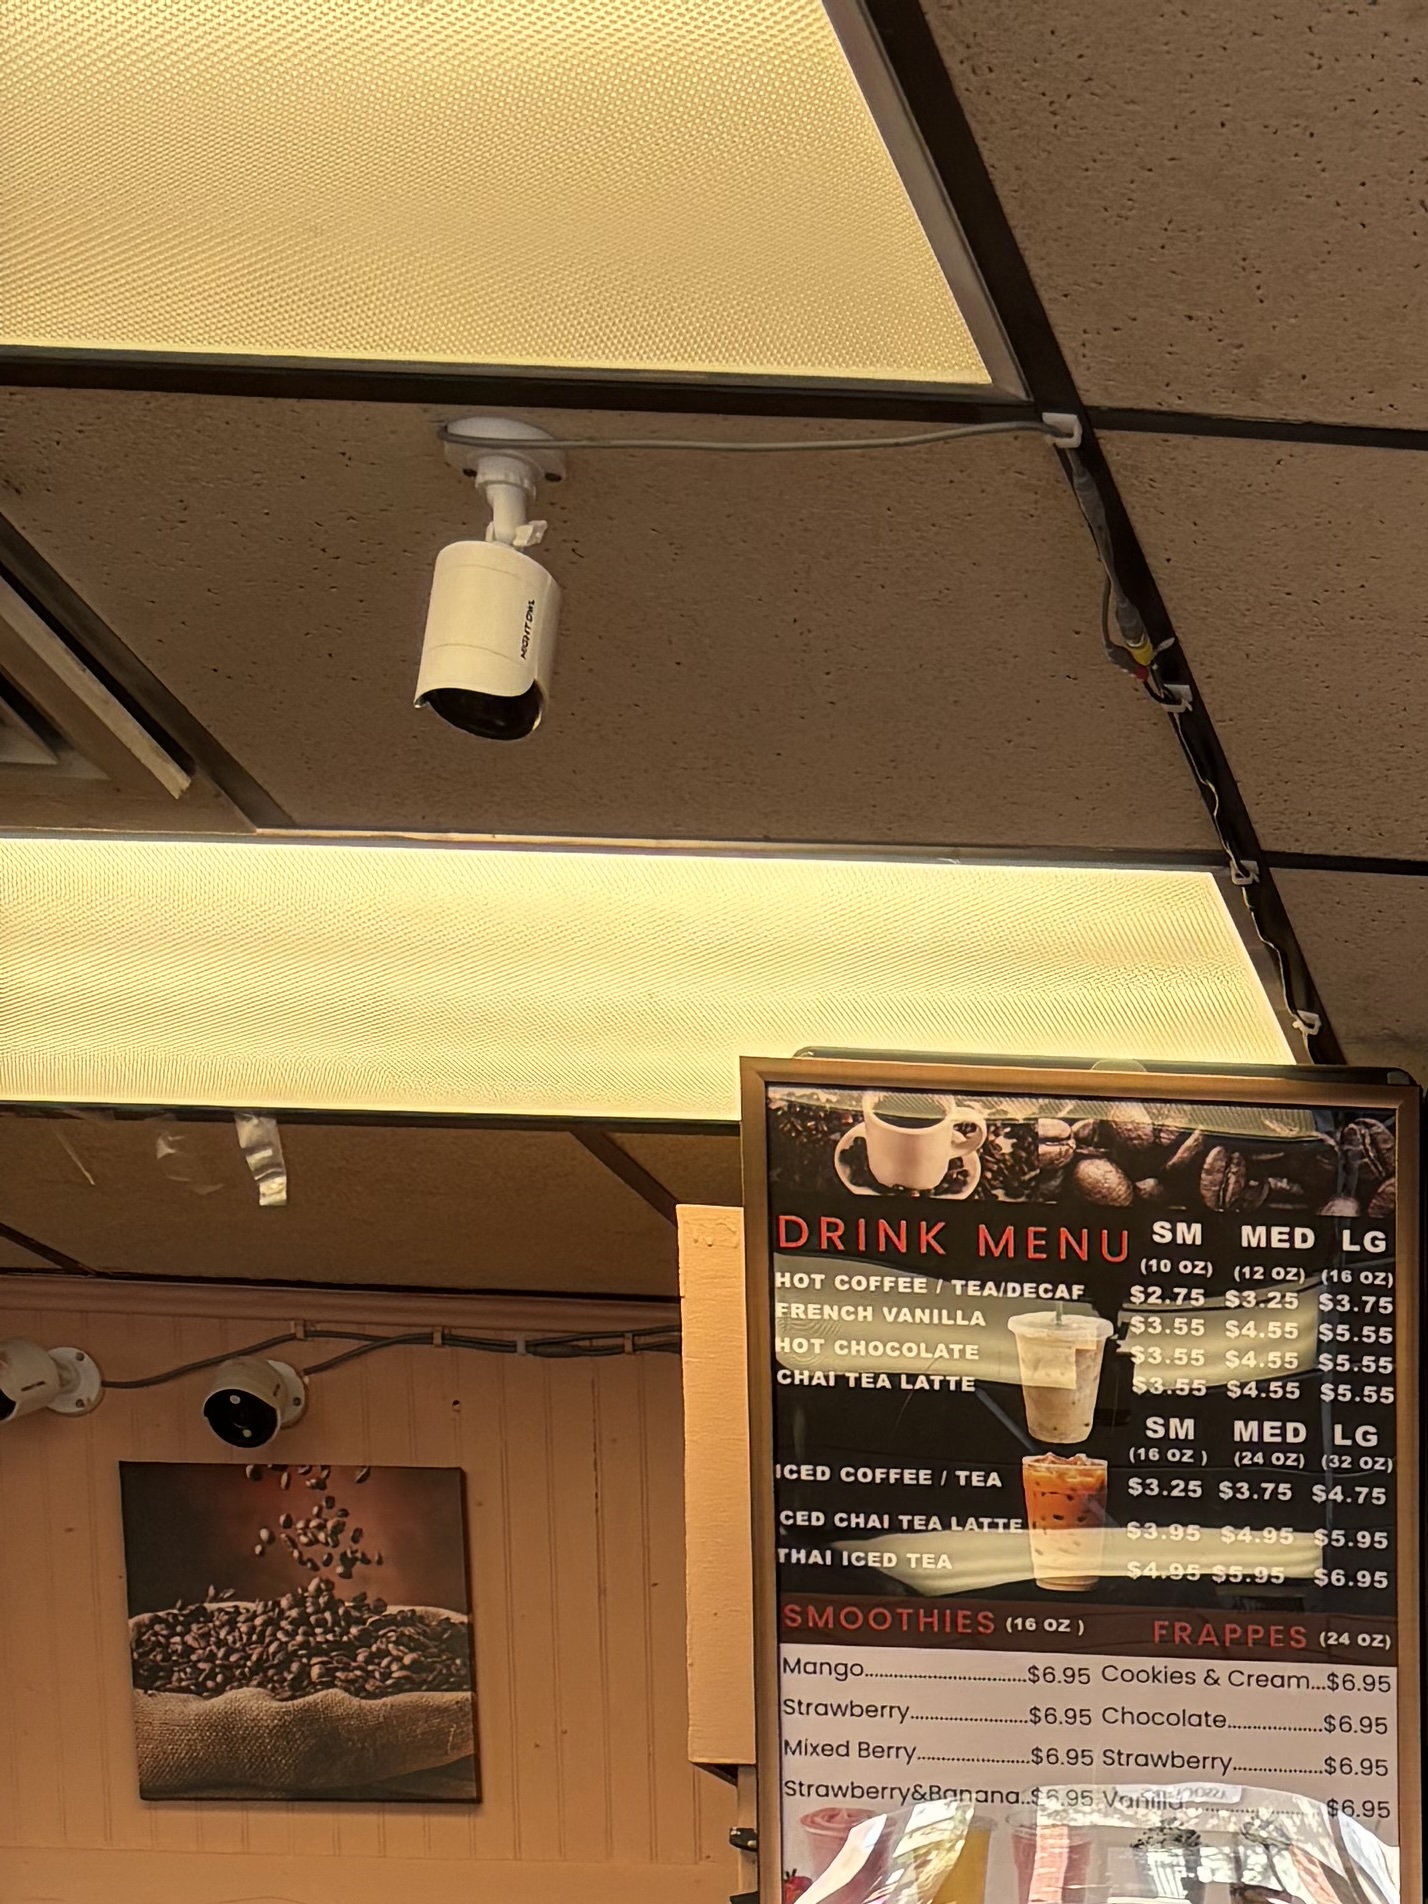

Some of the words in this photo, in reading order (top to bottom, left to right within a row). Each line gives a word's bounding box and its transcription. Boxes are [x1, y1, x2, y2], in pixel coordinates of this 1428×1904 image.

[777, 1215, 947, 1254] DRINK
[978, 1223, 1129, 1263] MENU
[1152, 1221, 1203, 1246] SM
[1241, 1225, 1316, 1249] MED
[1342, 1229, 1388, 1253] LG
[775, 1271, 826, 1290] HOT
[835, 1273, 927, 1295] COFFEE
[1130, 1286, 1205, 1306] $2.75
[1225, 1289, 1299, 1310] $3.25
[1319, 1293, 1394, 1314] $3.75
[776, 1303, 871, 1322] FRENCH
[881, 1306, 986, 1327] VANILLA
[775, 1336, 826, 1355] HOT
[834, 1339, 980, 1360] CHOCOLATE
[776, 1368, 835, 1387] CHAI
[844, 1371, 892, 1390] TEA
[899, 1373, 976, 1392] LATTE
[777, 1547, 834, 1566] THAI
[842, 1549, 899, 1568] ICED
[907, 1551, 952, 1570] TEA
[1314, 1567, 1389, 1589] $6.95
[784, 1604, 995, 1634] SMOOTHIES
[1153, 1620, 1308, 1649] FRAPPES
